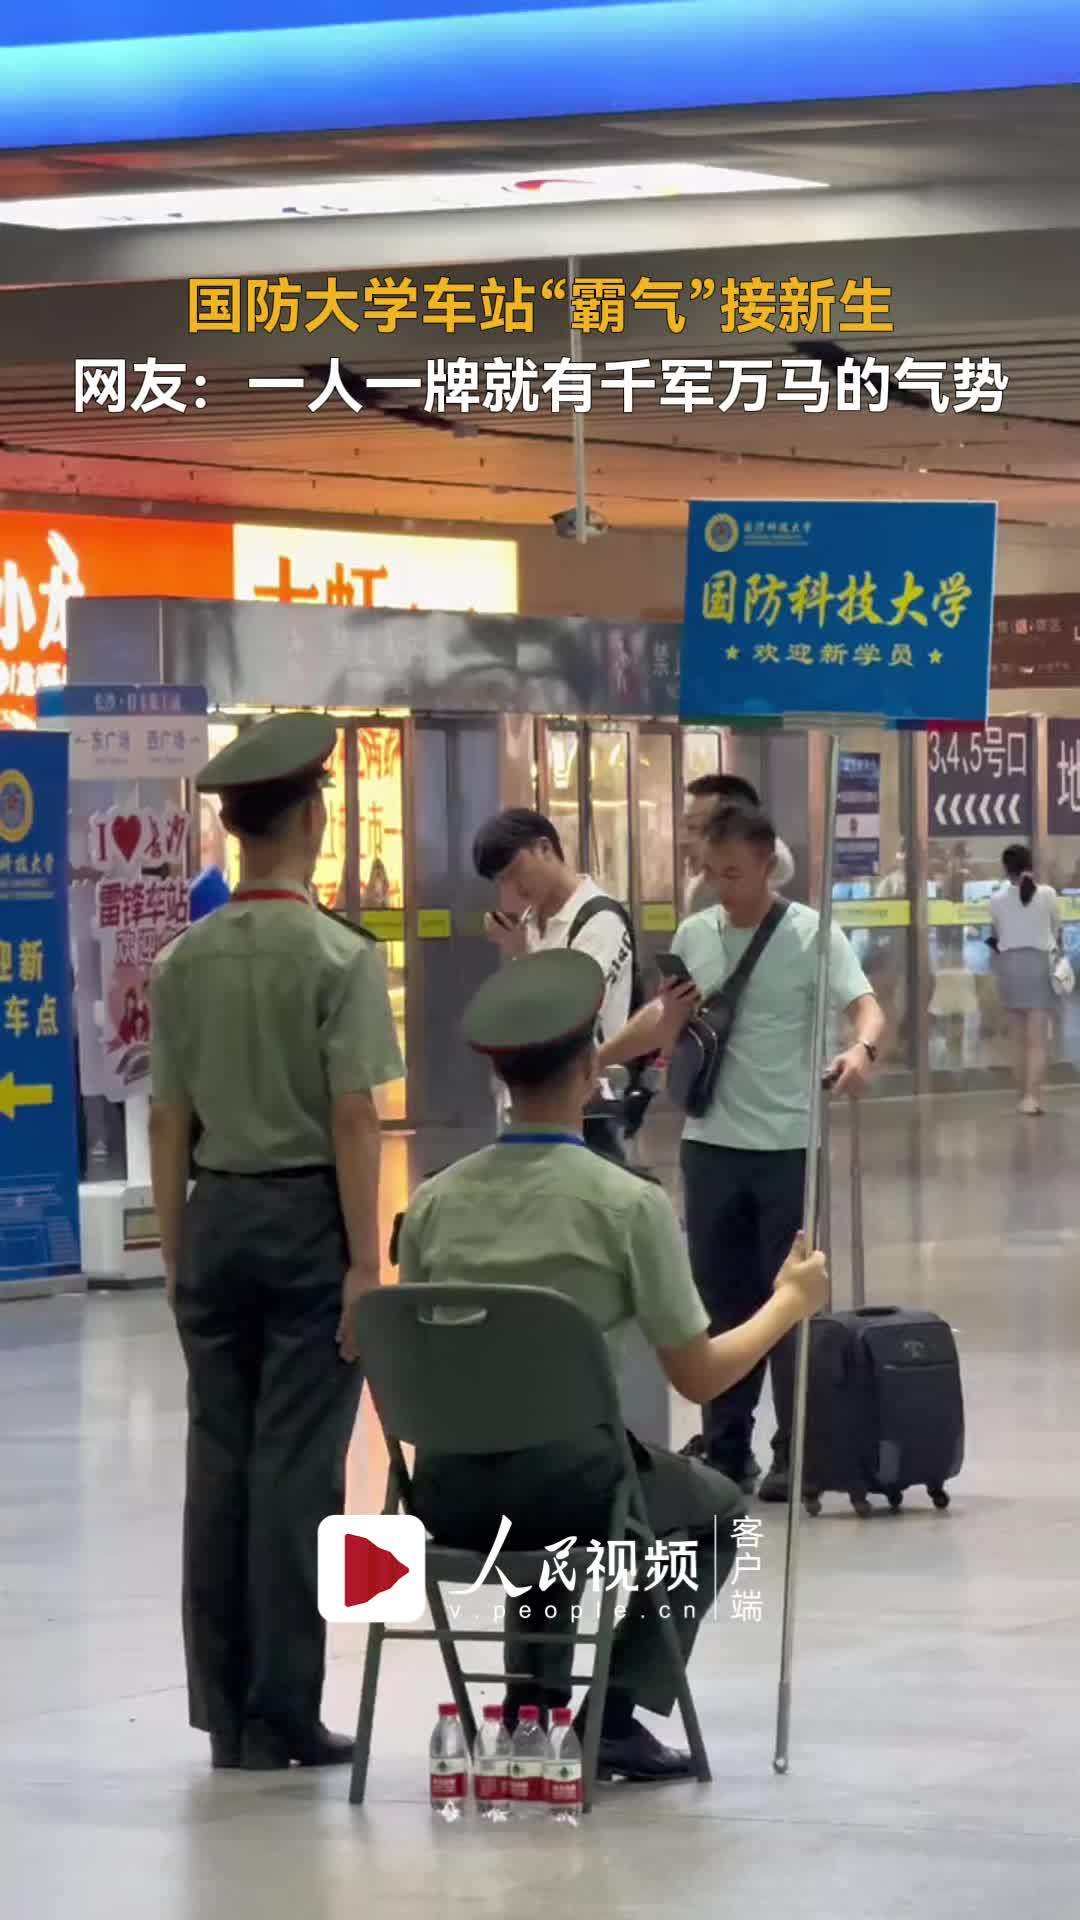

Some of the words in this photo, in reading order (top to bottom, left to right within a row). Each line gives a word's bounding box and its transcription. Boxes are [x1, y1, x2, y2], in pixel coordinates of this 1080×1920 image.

[702, 569, 972, 629] 国防科技大学
[753, 643, 914, 667] 欢迎新学员
[100, 881, 187, 928] 雷锋车站
